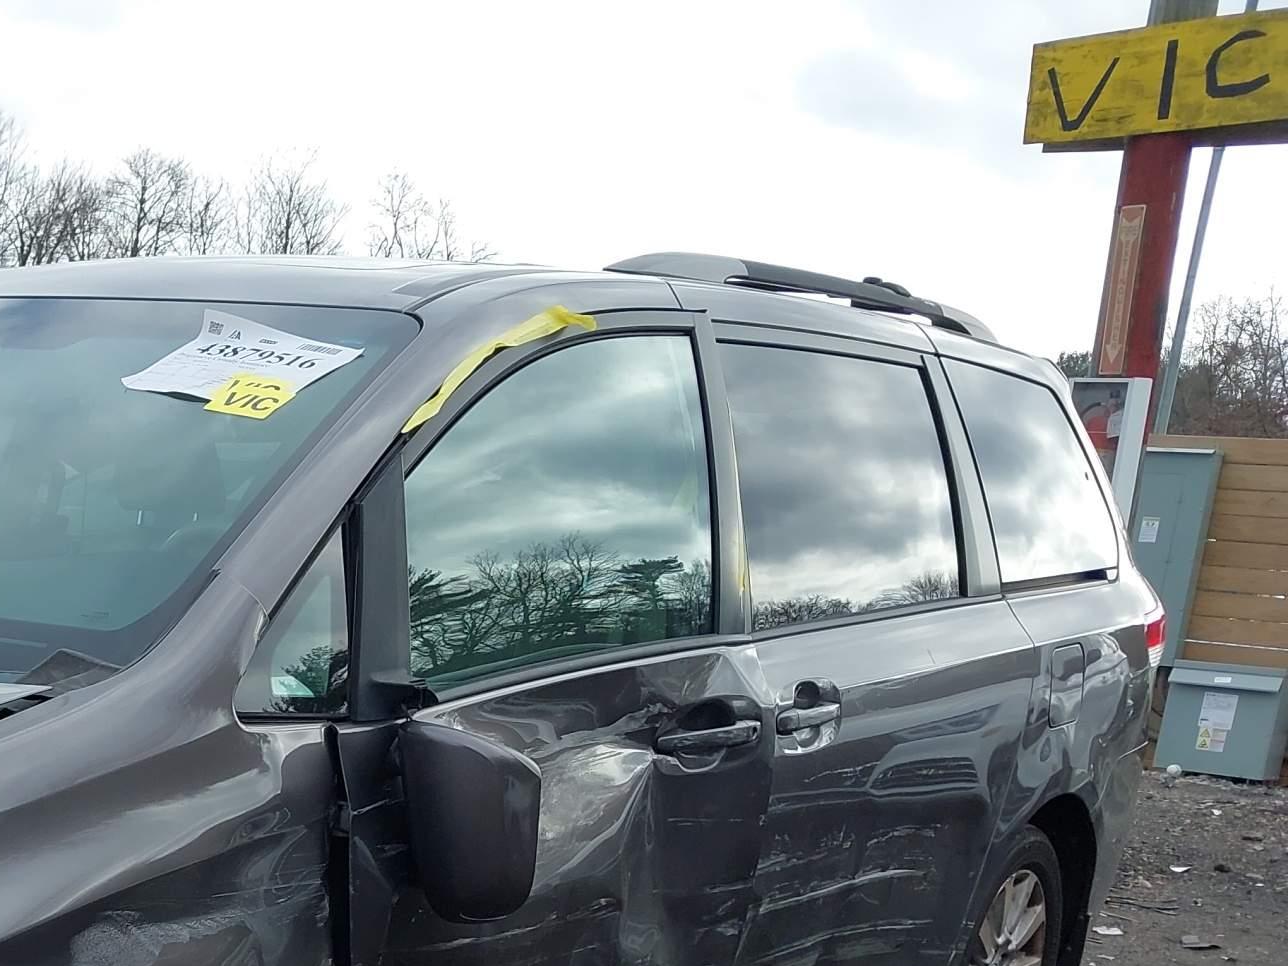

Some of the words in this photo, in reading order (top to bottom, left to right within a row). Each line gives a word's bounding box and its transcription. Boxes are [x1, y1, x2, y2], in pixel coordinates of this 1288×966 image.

[1047, 29, 1271, 132] VIC
[197, 343, 323, 368] 43879516
[223, 391, 280, 411] VIC
